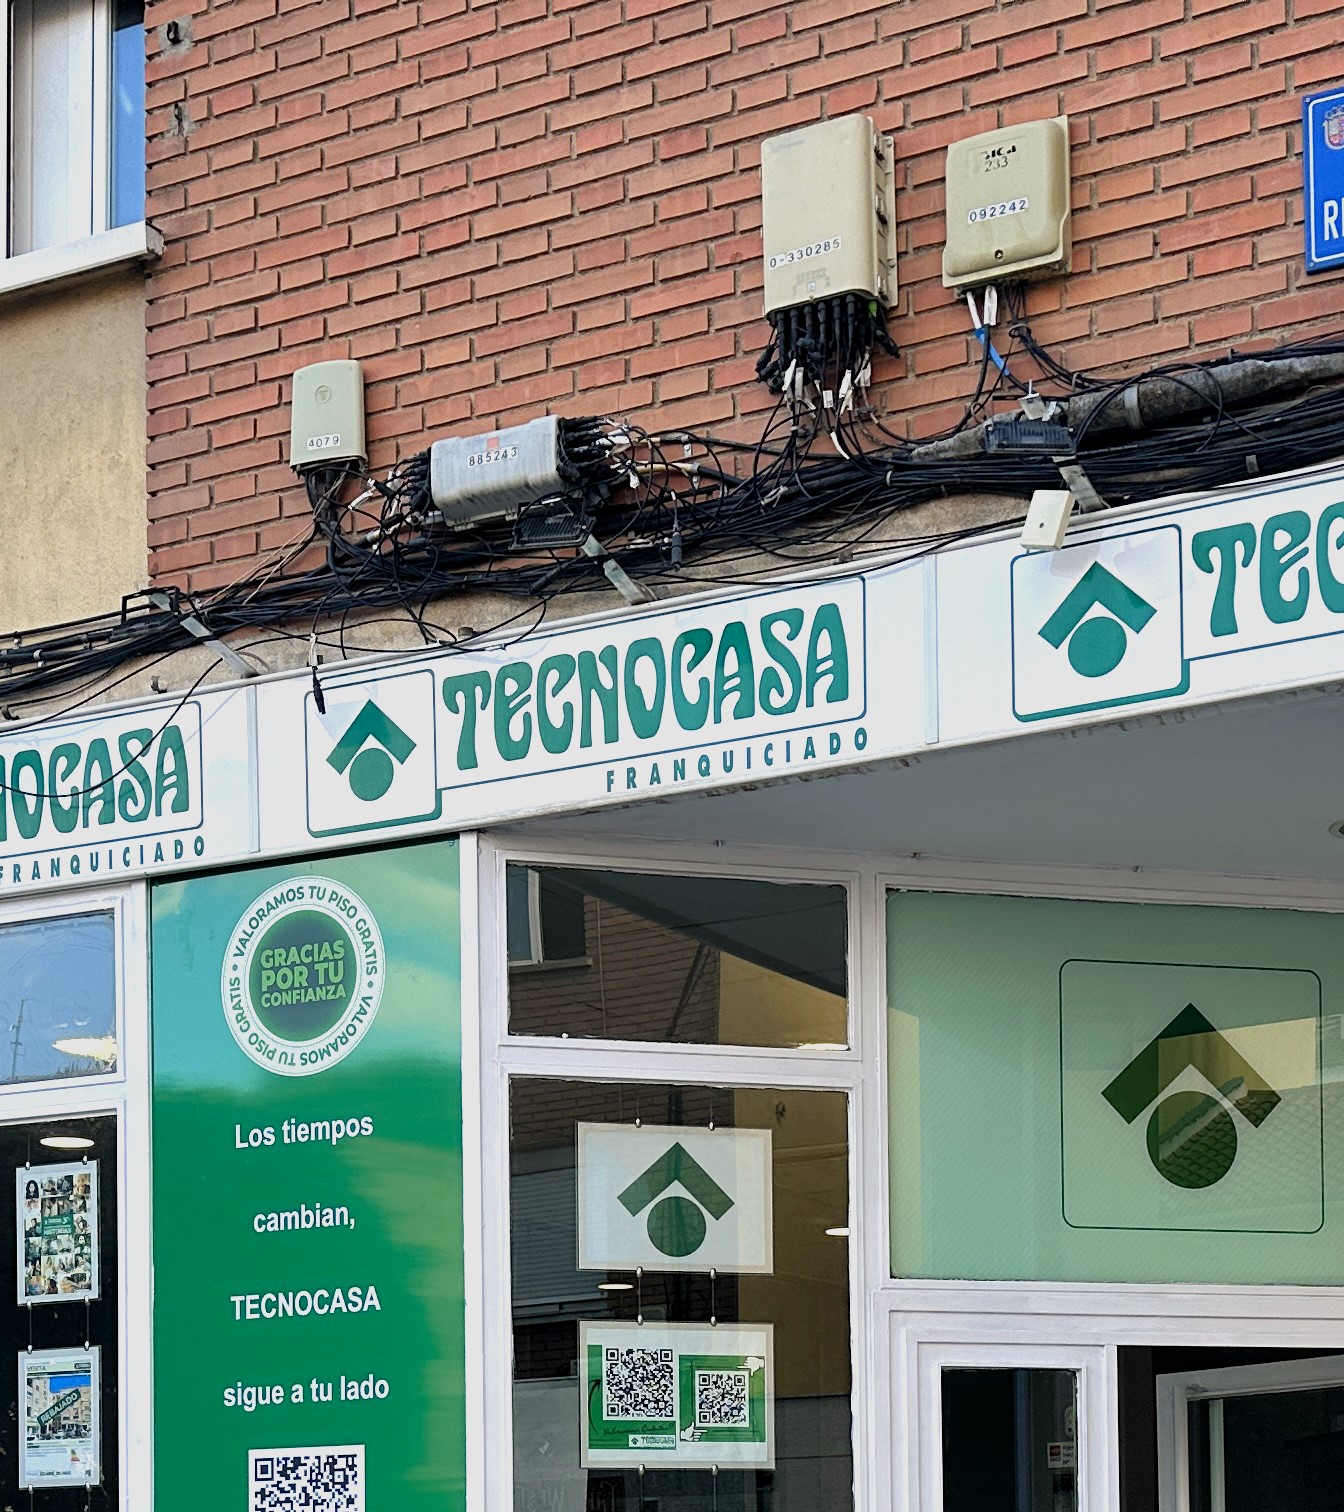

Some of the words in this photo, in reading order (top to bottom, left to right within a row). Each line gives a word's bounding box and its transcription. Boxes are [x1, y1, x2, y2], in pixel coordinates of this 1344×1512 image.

[969, 199, 1028, 222] 092242
[769, 238, 840, 268] 0-330285
[307, 435, 340, 449] 4079
[469, 446, 519, 467] 885243
[442, 602, 849, 770] TECNOCASA
[606, 726, 869, 793] FRANQUICIADO
[233, 886, 305, 958] VALORAMOS
[308, 885, 326, 900] TU
[328, 890, 358, 919] PISO
[355, 918, 378, 975] GRATIS
[260, 940, 345, 969] GRACIAS
[261, 965, 308, 992] POR
[314, 960, 344, 984] TU
[229, 976, 250, 1033] GRATIS
[261, 984, 346, 1008] CONFIANZA
[248, 1033, 276, 1060] PISO
[299, 996, 373, 1066] VALORAMOS
[279, 1051, 296, 1067] TU
[235, 1124, 275, 1148] Los
[282, 1116, 373, 1146] tiempos
[253, 1203, 355, 1233] cambian,
[230, 1286, 381, 1320] TECNOCASA
[40, 1391, 79, 1424] REBAJADO
[223, 1382, 284, 1412] sigue
[291, 1383, 304, 1403] a
[310, 1378, 332, 1402] tu
[340, 1374, 389, 1401] lado
